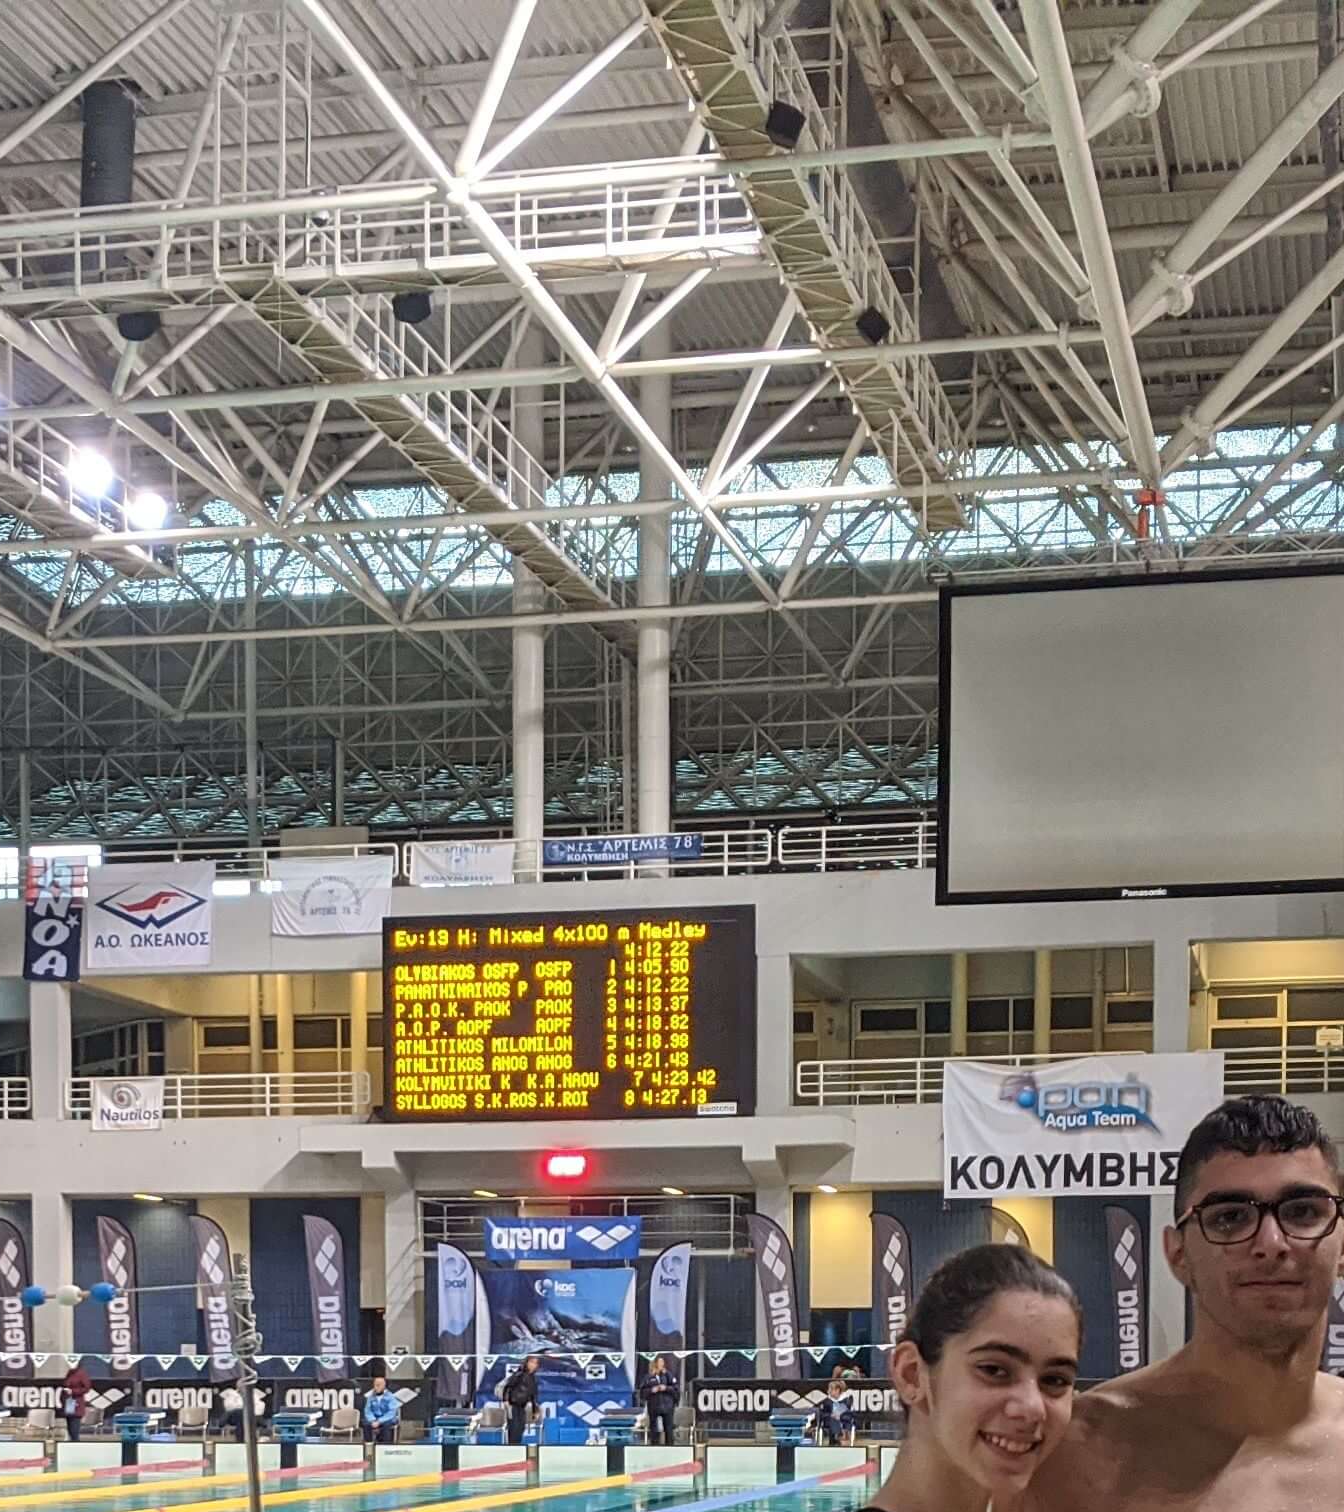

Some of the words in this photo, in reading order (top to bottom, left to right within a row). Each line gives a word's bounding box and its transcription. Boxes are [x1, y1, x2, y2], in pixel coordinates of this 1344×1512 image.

[1121, 888, 1167, 897] Panasonic
[130, 932, 209, 947] ΩΚΕΑΝΟΣ
[490, 927, 543, 944] Mixed
[554, 925, 607, 941] 4x100
[640, 922, 705, 939] Medley
[626, 941, 688, 958] 4:12.22
[483, 963, 519, 979] OSFP
[536, 961, 572, 977] OSFP
[625, 958, 688, 975] 4:05.90
[396, 982, 510, 999] PANATHINAIKOS
[545, 980, 571, 995] PAO
[626, 977, 688, 993] 4:12.22
[396, 1002, 464, 1018] P.A.O.K.
[475, 1001, 510, 1016] PAOK
[536, 999, 572, 1014] PAOK
[625, 996, 688, 1012] 4:13.37
[396, 1021, 447, 1036] A.O.P.
[457, 1019, 492, 1035] AOPF
[536, 1017, 571, 1033] AOPF
[625, 1015, 688, 1030] 4:18.82
[396, 1039, 483, 1055] ATHLITIKOS
[626, 1033, 688, 1049] 4:18.98
[396, 1057, 484, 1073] ATHLITIKOS
[625, 1052, 688, 1068] 4:21.43
[652, 1070, 715, 1086] 4:23.42
[397, 1094, 466, 1109] SYLLOGOS
[643, 1089, 709, 1106] 4:27.13
[100, 1108, 159, 1121] Nautilos
[1045, 1114, 1087, 1131] Aqua
[1092, 1110, 1136, 1126] Team
[491, 1226, 566, 1250] arena
[146, 1387, 212, 1409] arena
[285, 1388, 355, 1410] arena
[698, 1388, 770, 1412] arena
